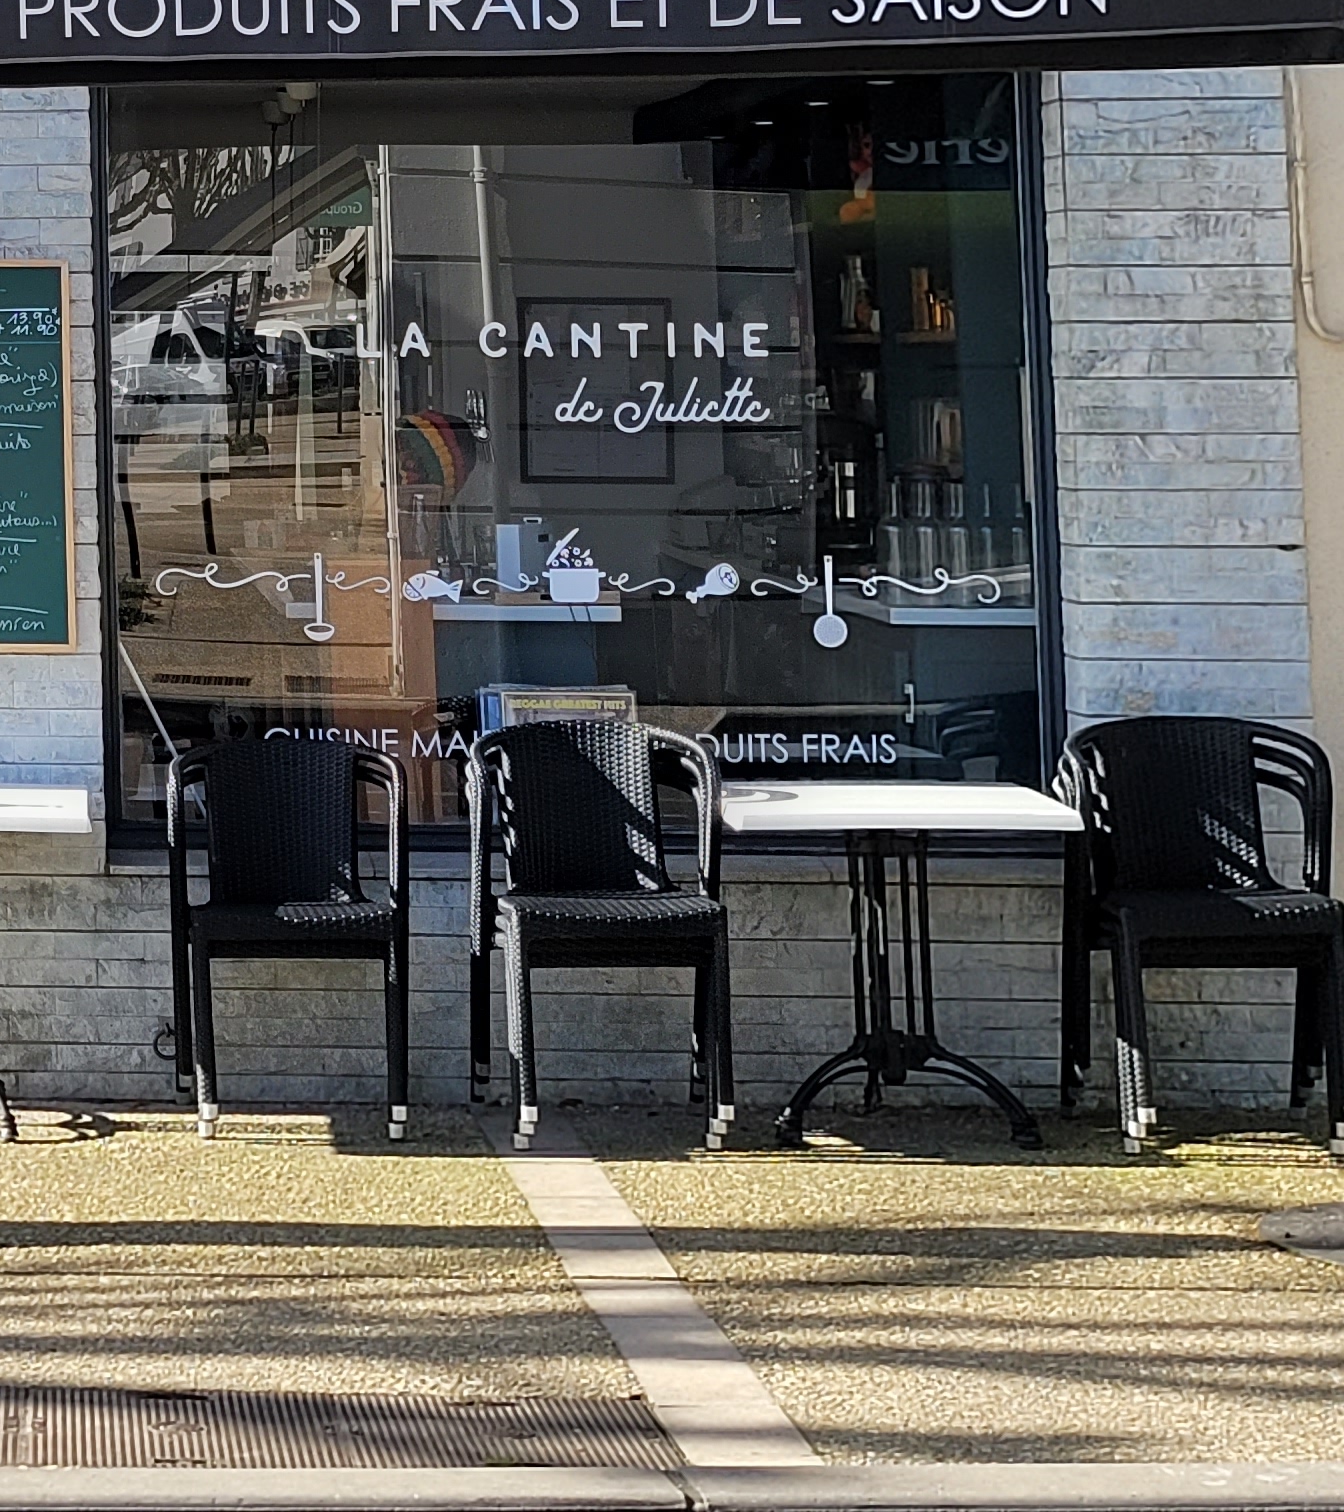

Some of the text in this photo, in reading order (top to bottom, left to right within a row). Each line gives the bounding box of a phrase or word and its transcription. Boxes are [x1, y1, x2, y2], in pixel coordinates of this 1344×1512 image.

[6, 311, 52, 326] 13.90
[11, 324, 58, 336] 11.90
[355, 321, 769, 360] LA CANTINE
[554, 376, 771, 435] de Juliette
[802, 734, 897, 764] FRAIS
